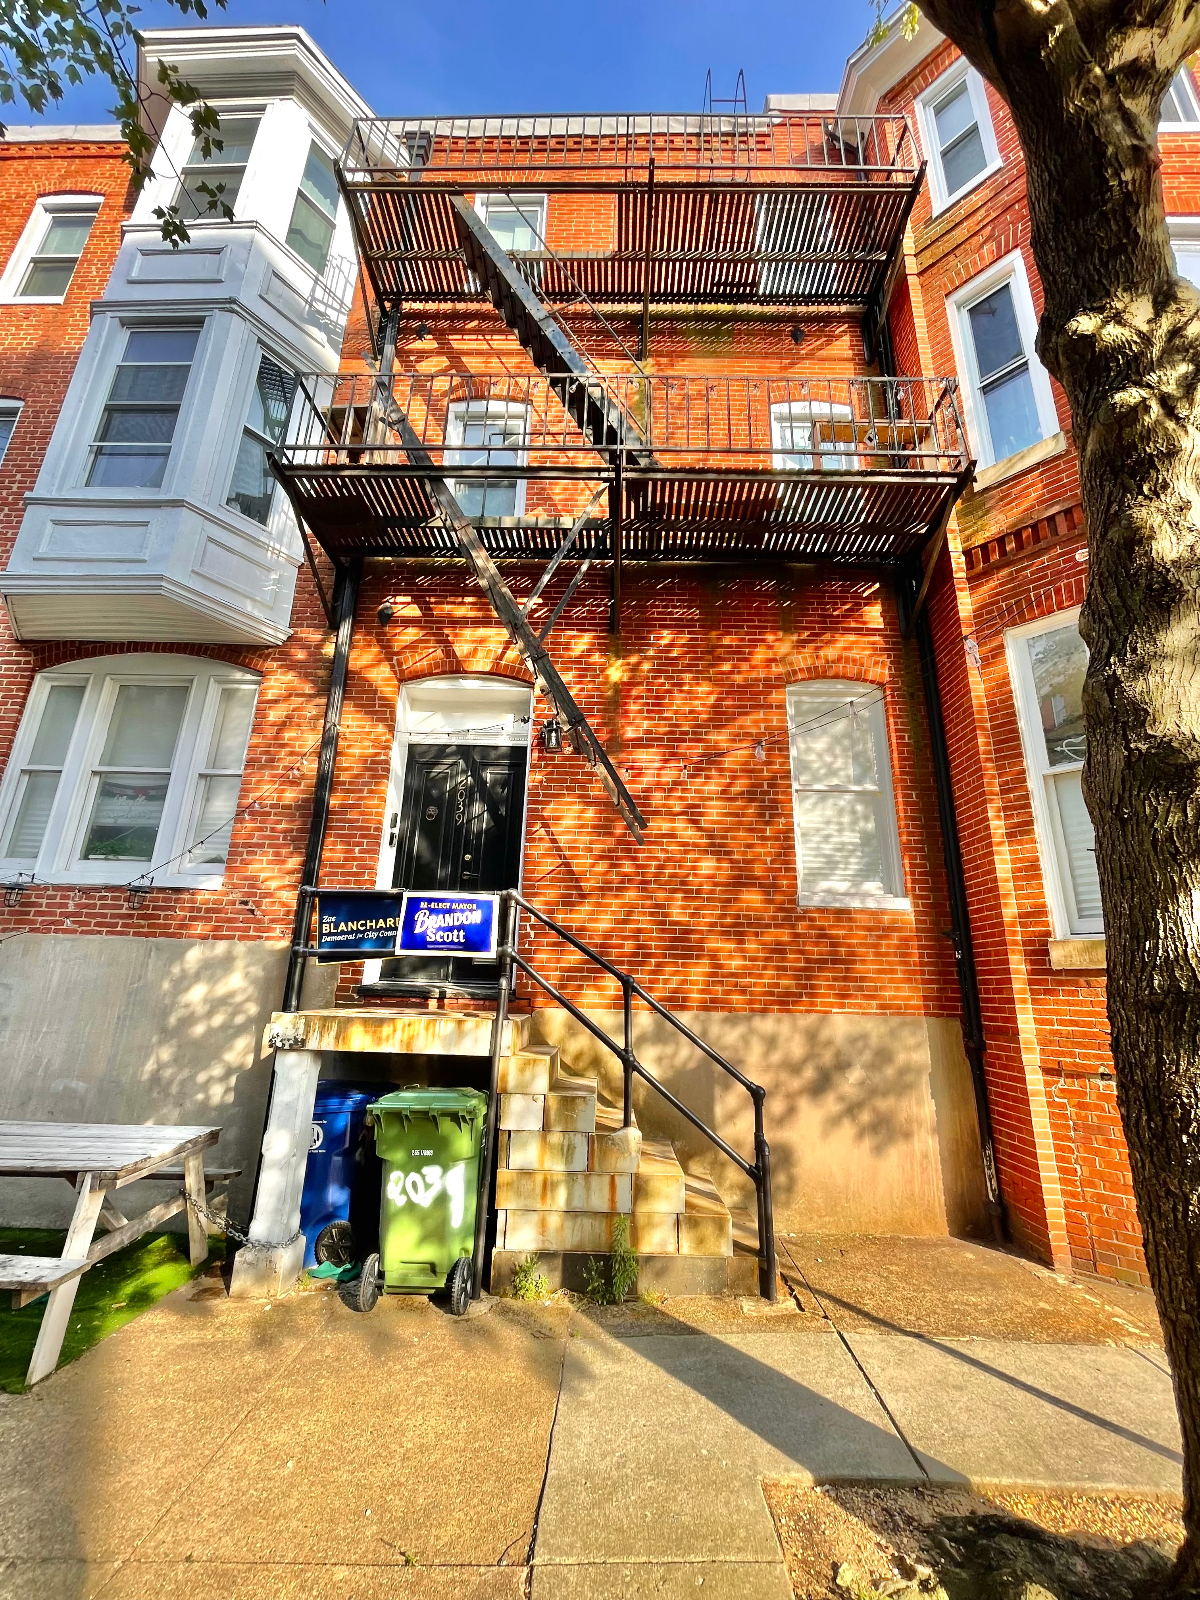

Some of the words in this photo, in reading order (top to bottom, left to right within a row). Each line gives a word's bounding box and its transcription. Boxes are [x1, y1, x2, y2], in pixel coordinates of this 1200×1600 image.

[455, 777, 467, 826] 2039
[452, 902, 477, 910] MAYOR
[413, 909, 482, 934] BRANDON
[321, 932, 356, 943] Democrat
[364, 930, 379, 939] City
[379, 930, 397, 938] Coun
[426, 928, 466, 943] Scott
[387, 1162, 466, 1229] 2039
